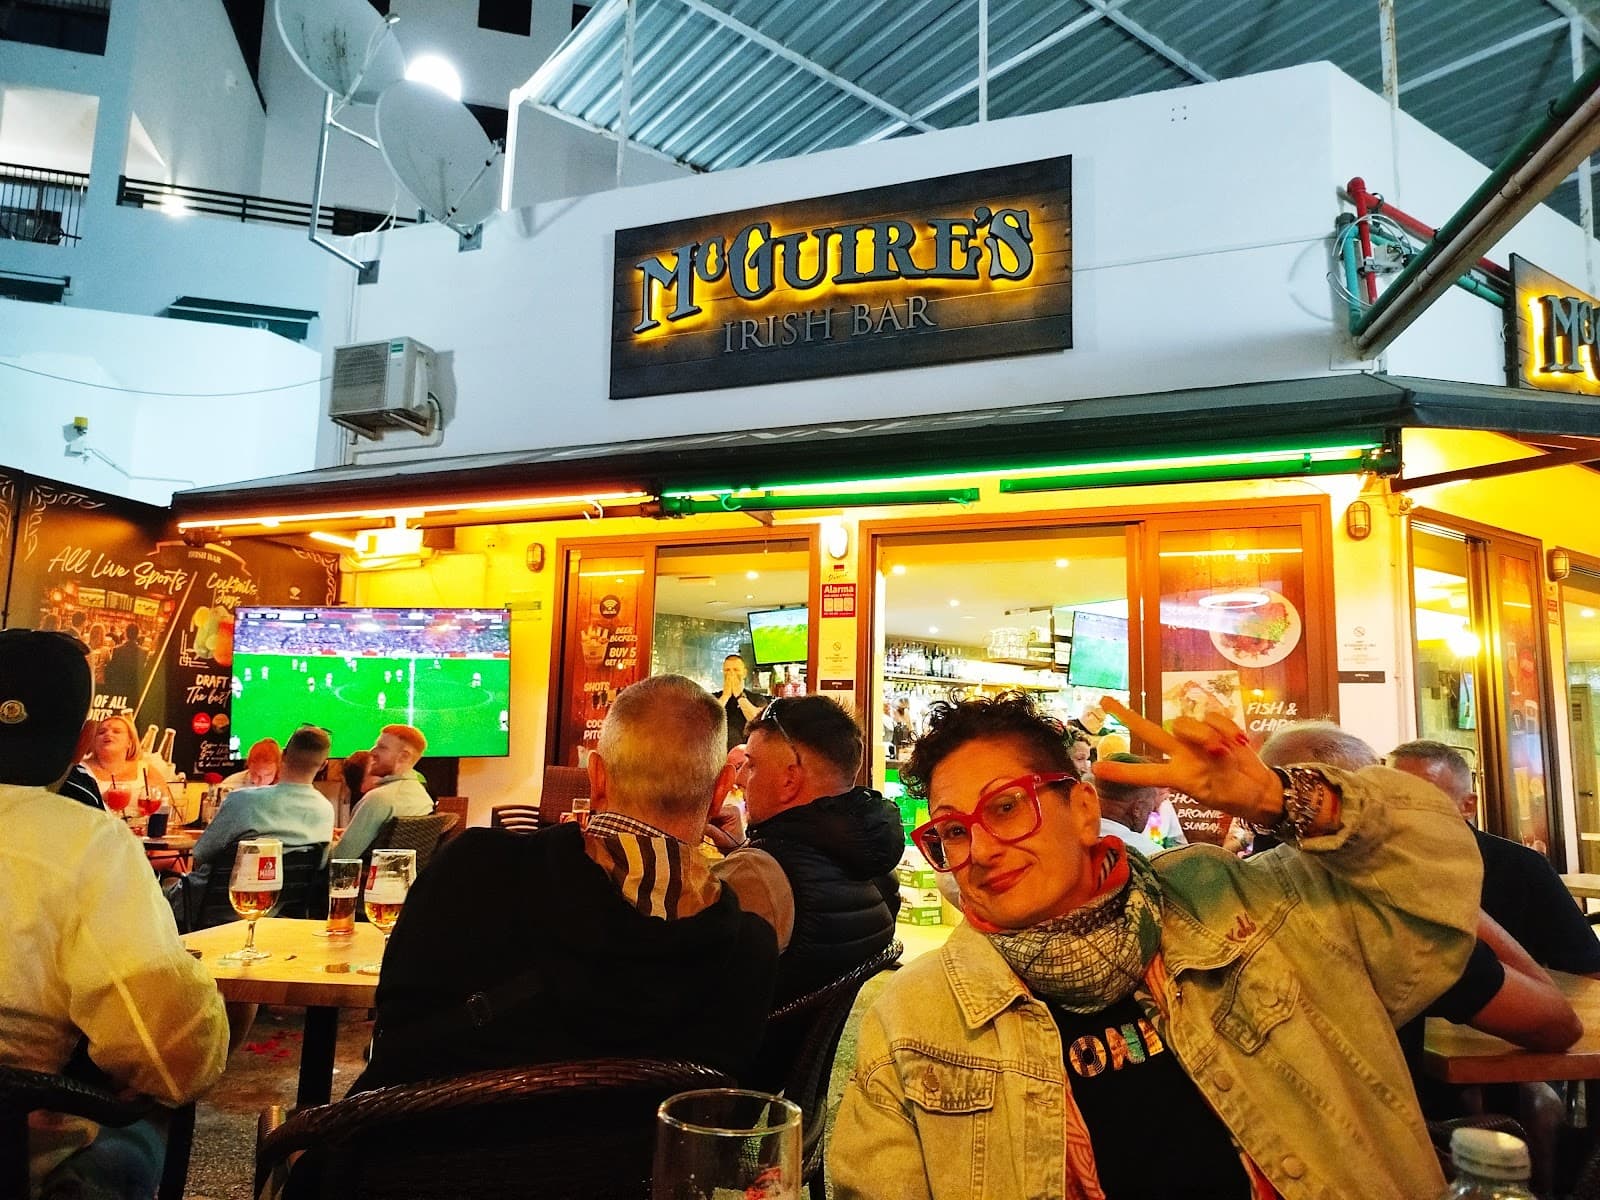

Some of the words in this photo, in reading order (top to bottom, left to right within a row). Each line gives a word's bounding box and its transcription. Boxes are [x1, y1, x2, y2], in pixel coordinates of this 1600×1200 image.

[723, 308, 832, 353] IRISH
[851, 295, 937, 337] BAR
[1538, 295, 1600, 376] Mc
[48, 546, 89, 573] All
[91, 553, 129, 579] Live
[133, 562, 188, 594] Sports
[824, 585, 854, 594] Alarma
[609, 647, 629, 658] BUY
[196, 674, 229, 688] DRAFT
[583, 681, 610, 692] SHOTS
[94, 694, 109, 708] OF
[109, 695, 128, 709] ALL
[187, 686, 207, 704] The
[1246, 701, 1284, 715] FISH
[1286, 702, 1299, 716] &
[1178, 808, 1225, 819] BROWNIE
